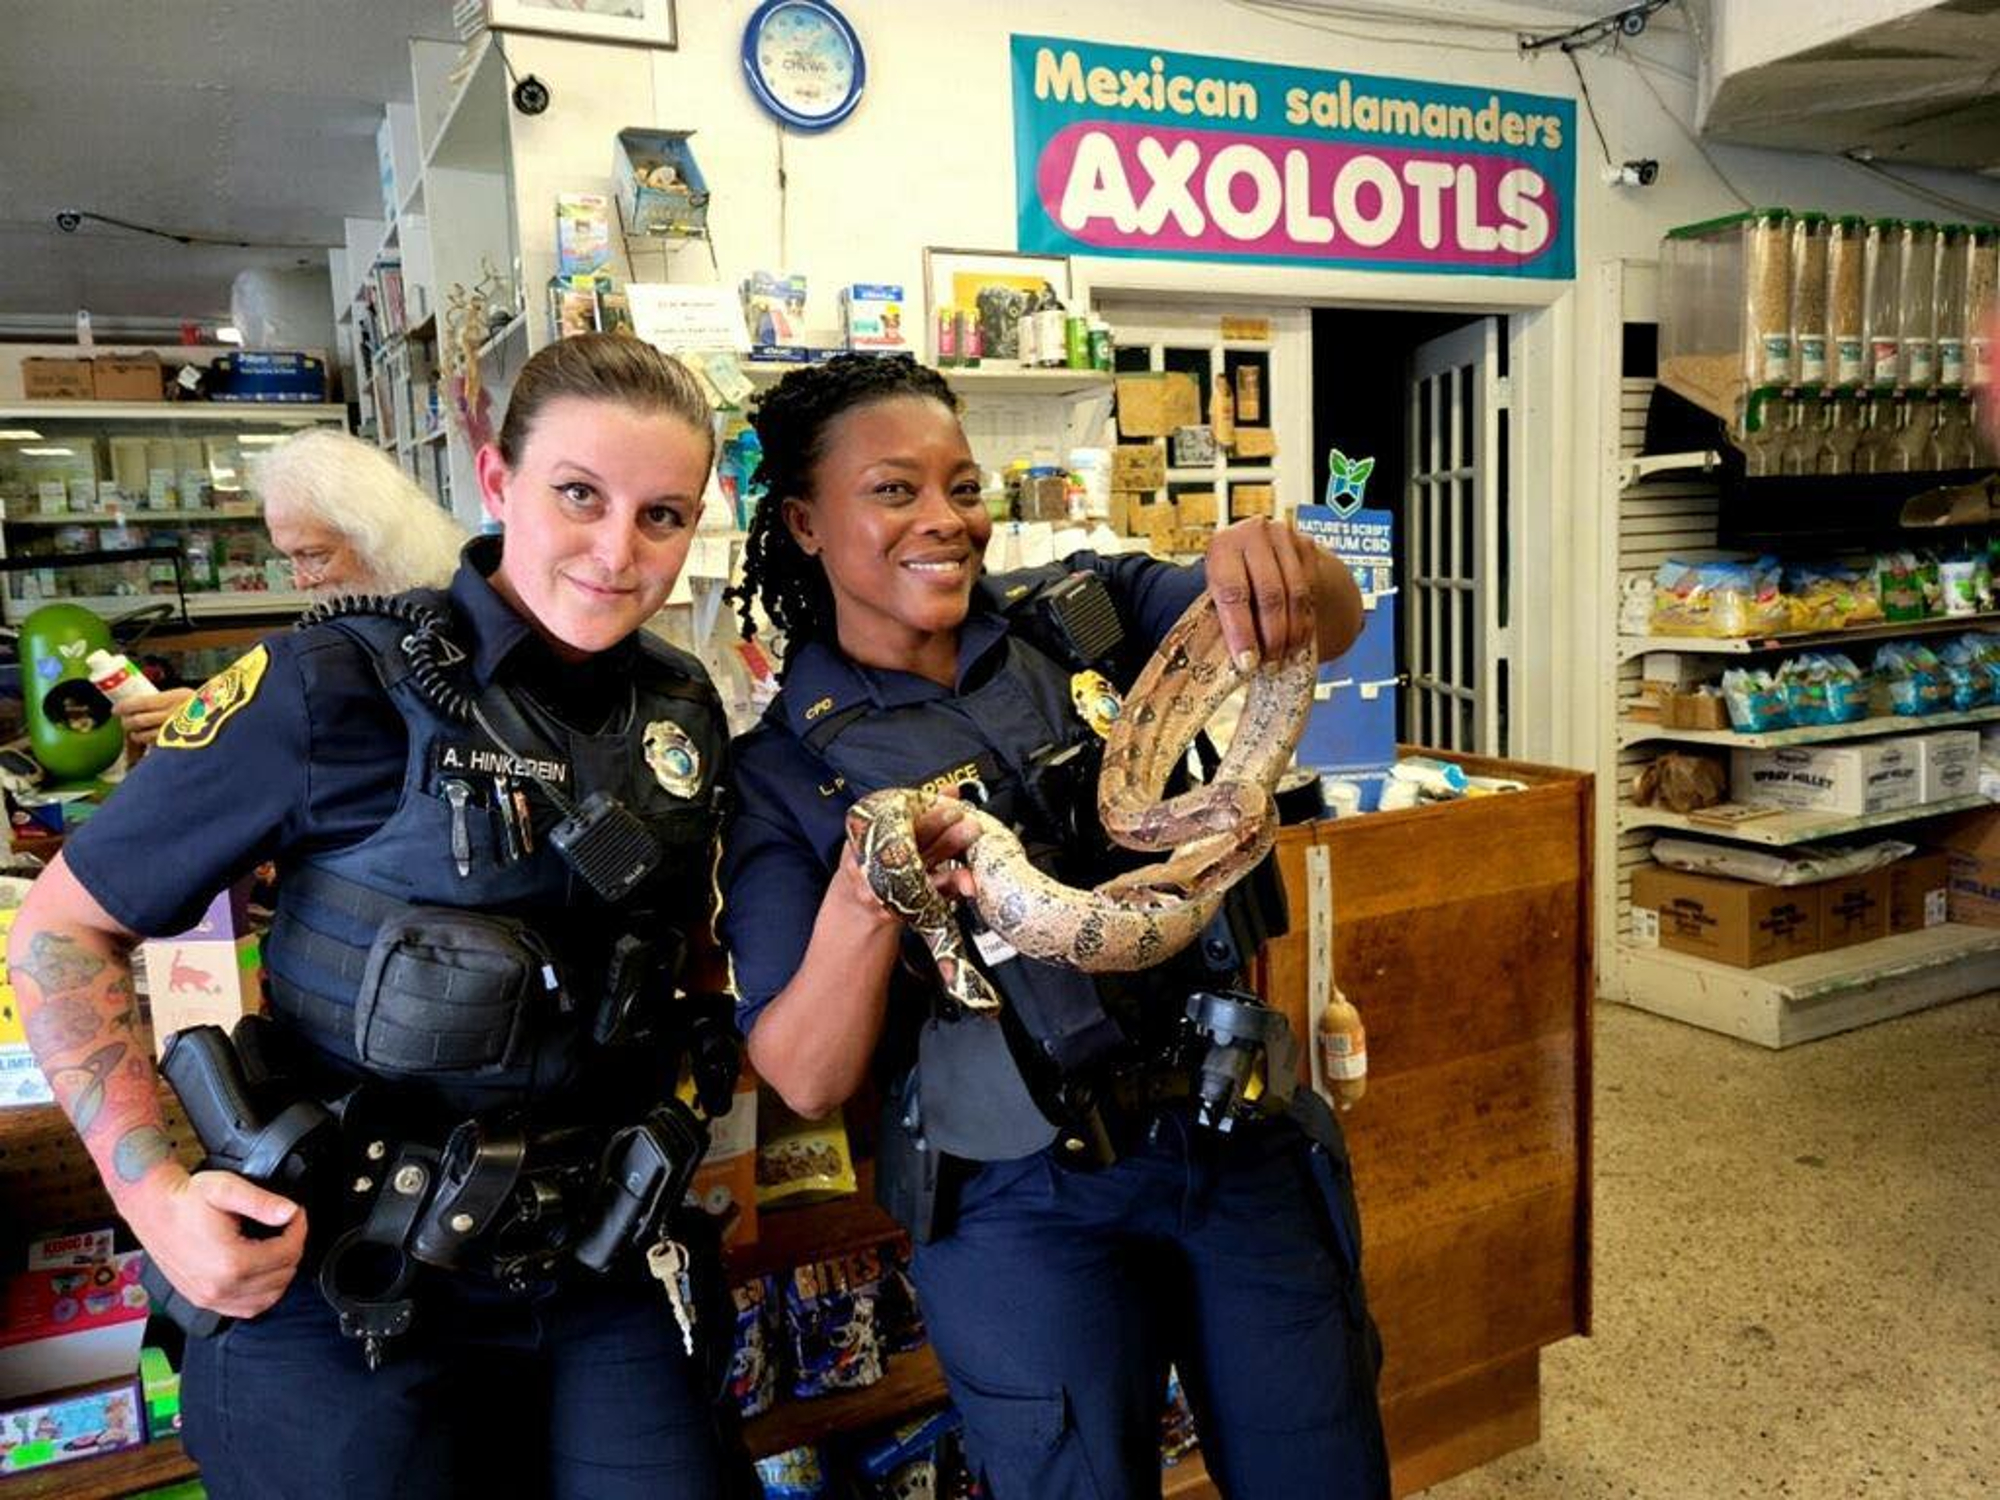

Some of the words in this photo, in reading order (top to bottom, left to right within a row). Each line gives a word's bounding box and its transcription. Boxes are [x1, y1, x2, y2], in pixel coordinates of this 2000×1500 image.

[1035, 47, 1258, 121] Mexican
[1285, 80, 1563, 149] salamanders
[1059, 131, 1550, 254] AXOLOTLS
[1362, 536, 1391, 553] CBD
[442, 747, 464, 768] A.
